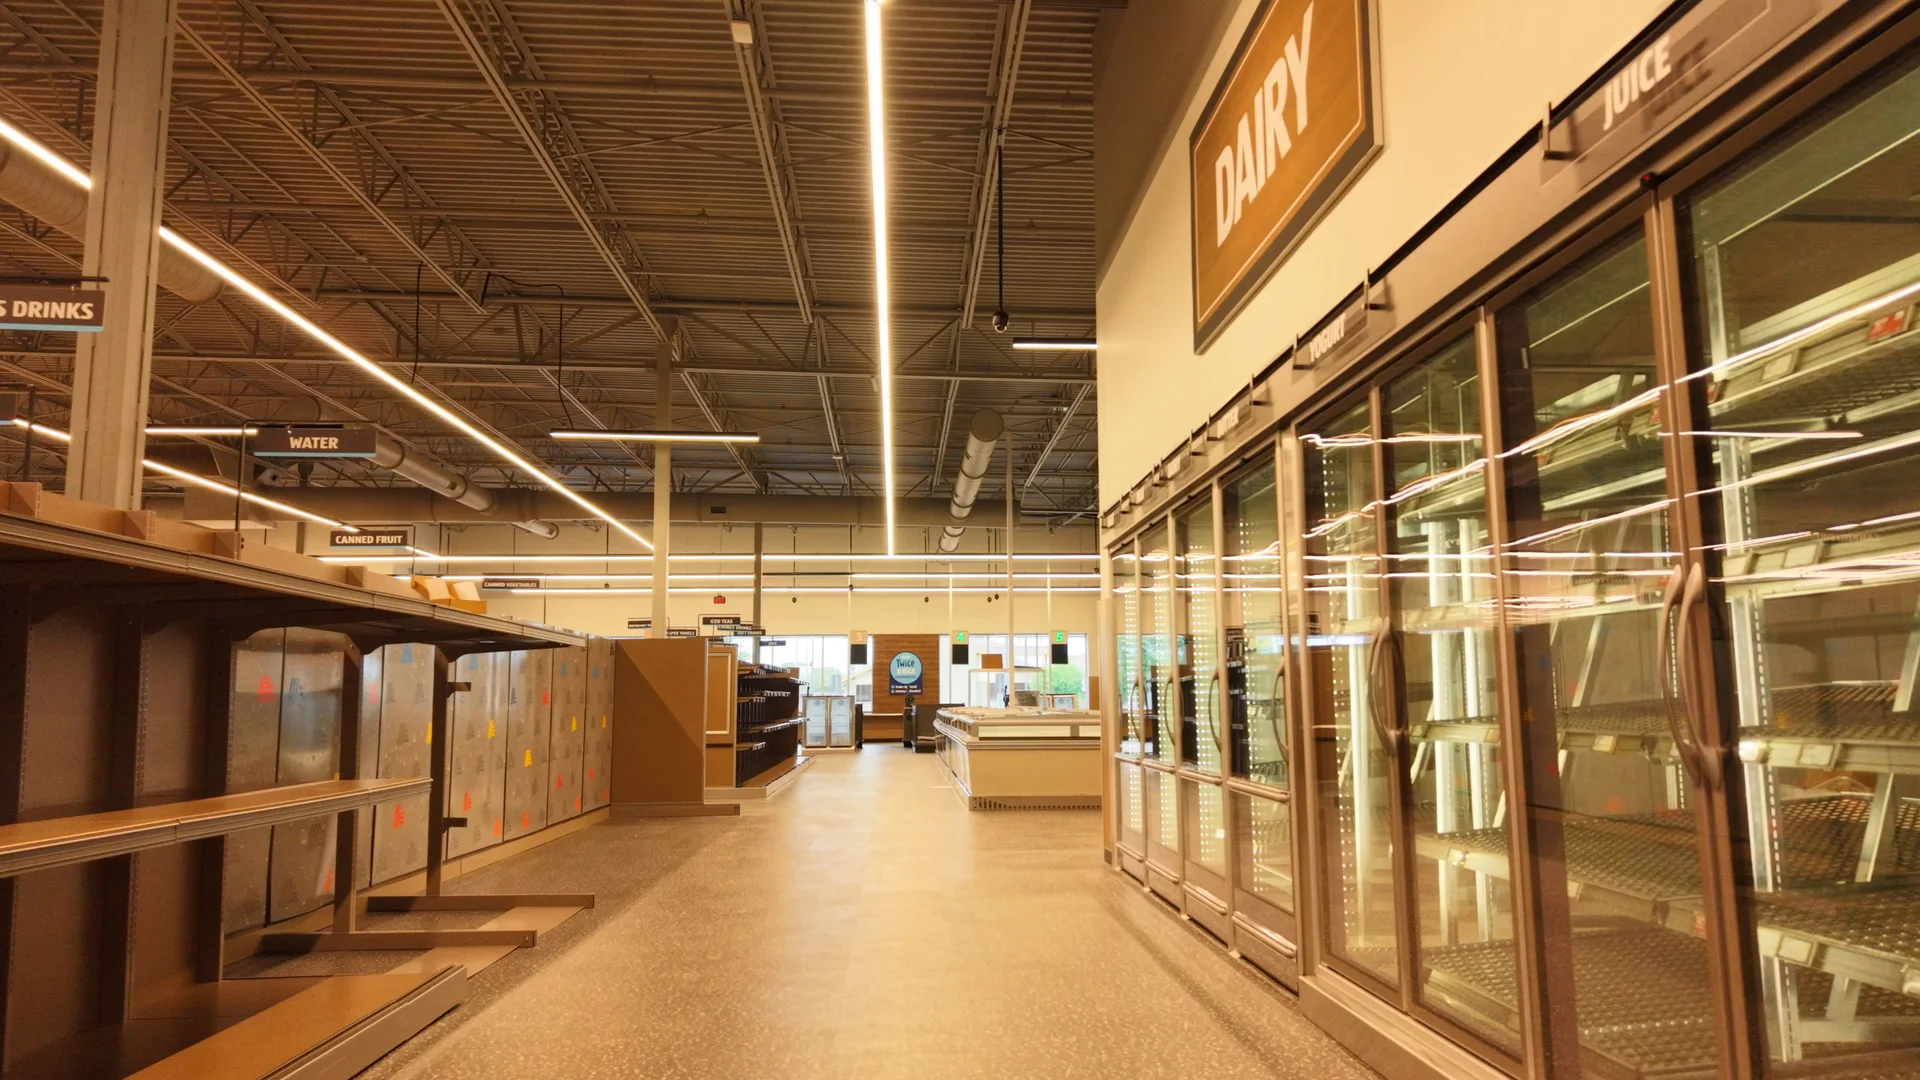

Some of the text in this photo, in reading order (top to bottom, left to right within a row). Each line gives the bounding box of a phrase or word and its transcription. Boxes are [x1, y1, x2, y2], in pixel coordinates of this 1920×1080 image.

[1603, 34, 1671, 130] JUICE
[1215, 1, 1313, 247] DAIRY
[12, 300, 94, 320] DRINKS
[1309, 312, 1345, 362] YOGURT
[289, 437, 338, 449] WATER
[335, 535, 402, 544] CANNED FRUIT
[856, 632, 862, 641] 3
[956, 632, 964, 642] 4
[1055, 631, 1063, 642] 5
